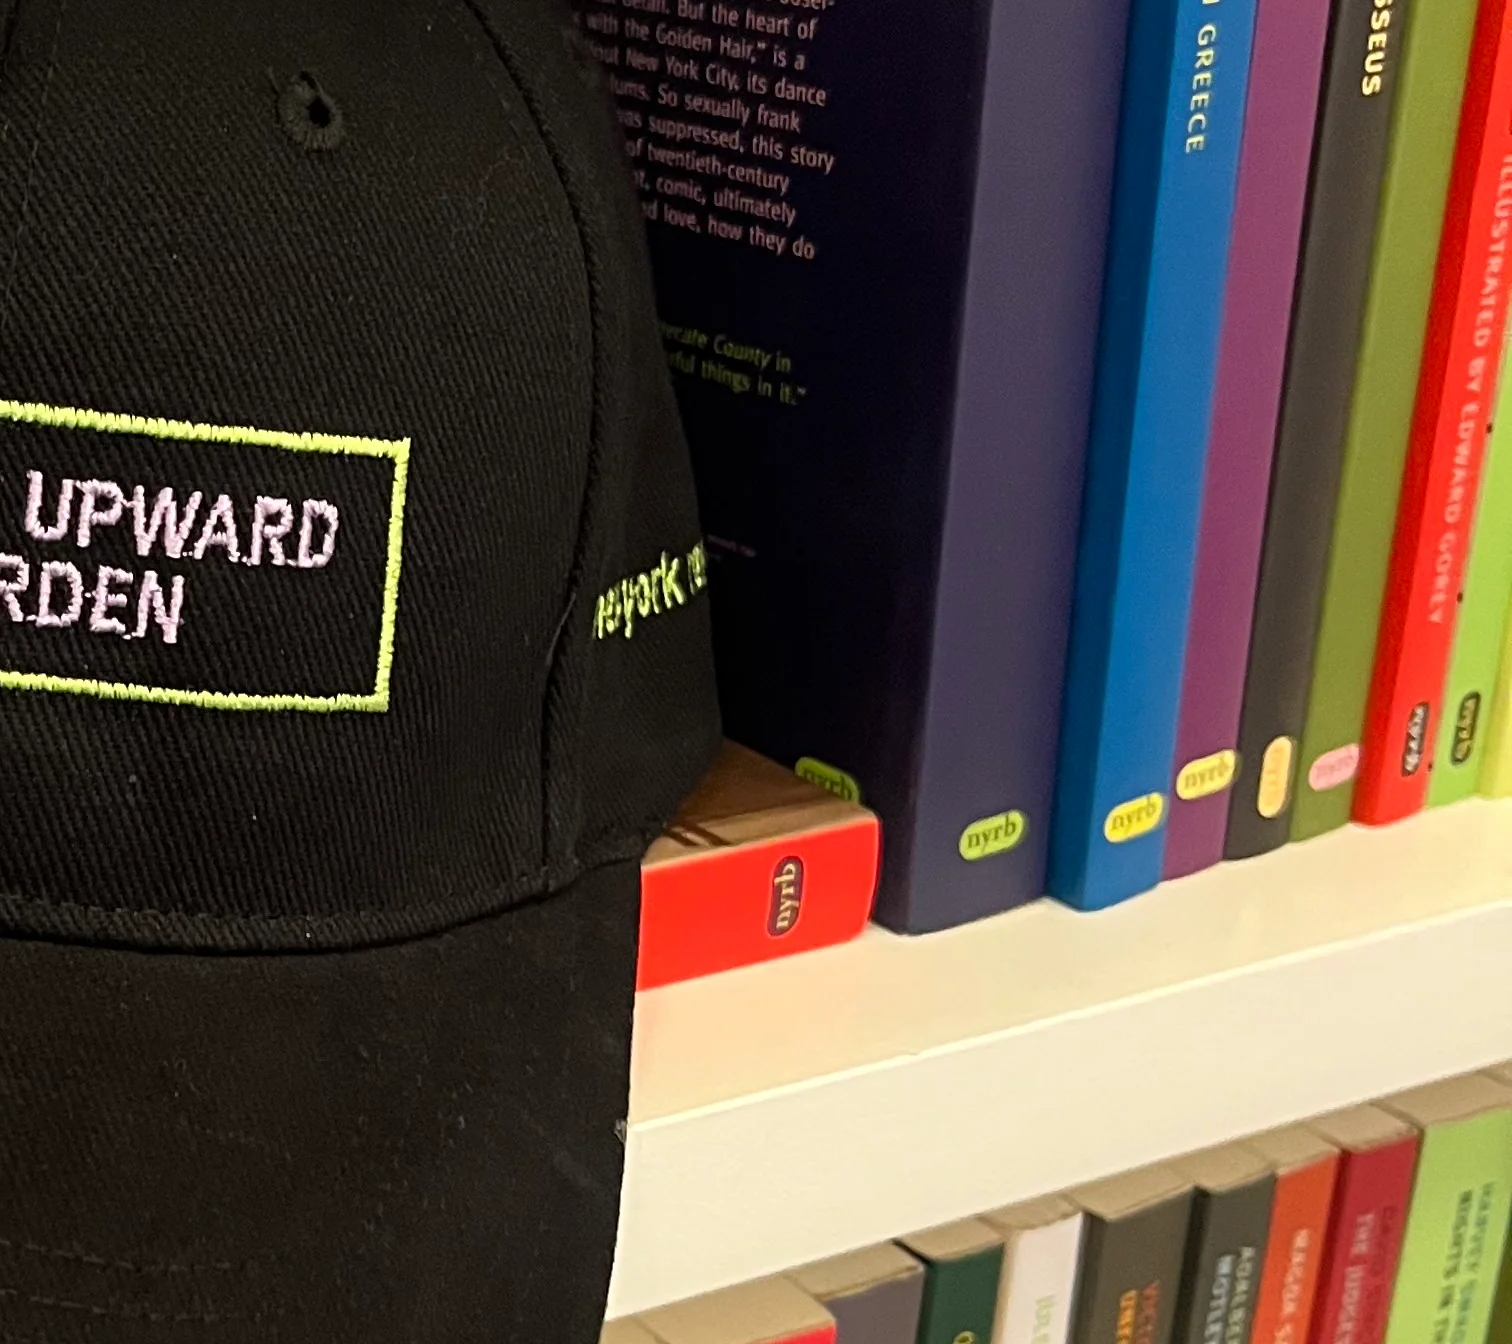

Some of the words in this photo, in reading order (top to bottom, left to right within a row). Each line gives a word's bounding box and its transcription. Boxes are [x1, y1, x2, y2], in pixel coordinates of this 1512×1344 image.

[745, 9, 789, 37] heart
[797, 17, 818, 40] of
[665, 55, 699, 80] York
[775, 78, 826, 107] dance
[1185, 24, 1216, 153] GREECE
[757, 105, 800, 134] frank
[752, 137, 783, 160] this
[790, 145, 834, 175] story
[714, 190, 796, 227] ultimately
[750, 225, 786, 256] they
[793, 235, 815, 260] do
[1468, 355, 1486, 392] BY
[1444, 402, 1480, 524] EDWARD
[25, 469, 340, 570] UPWARD
[966, 814, 1018, 852] nyrb
[1109, 796, 1160, 834] nyrb
[774, 863, 799, 929] nyrb
